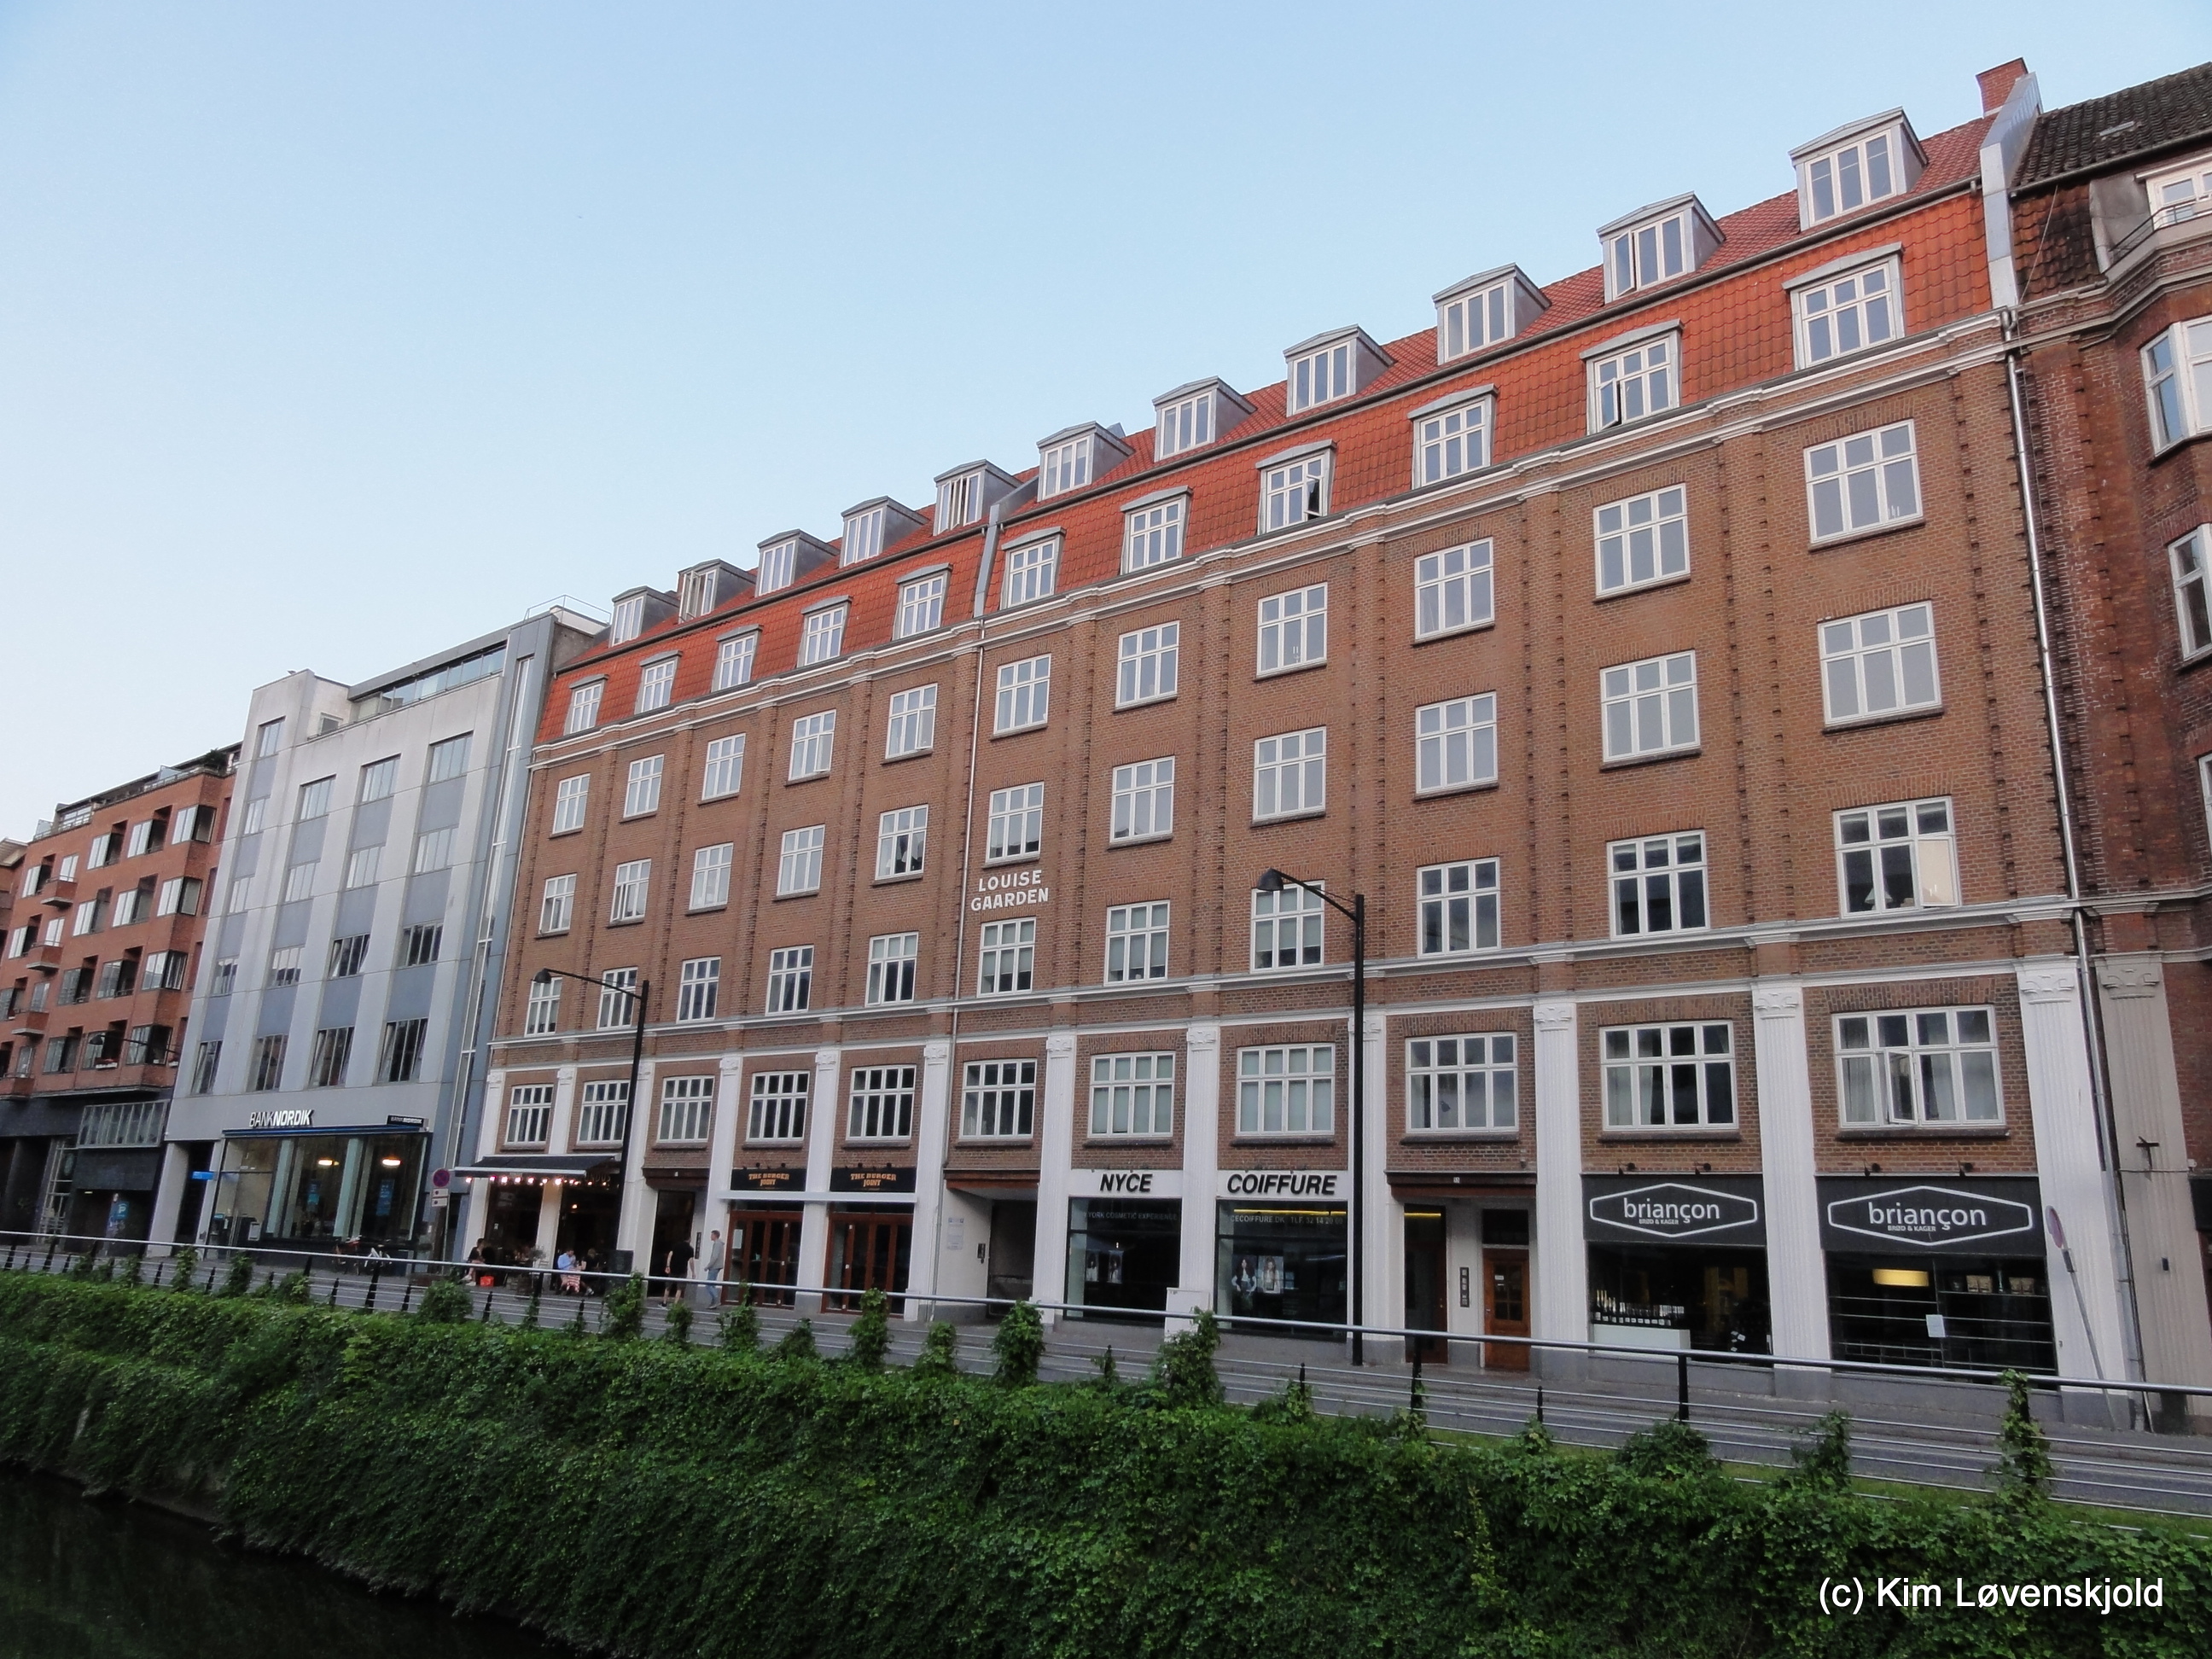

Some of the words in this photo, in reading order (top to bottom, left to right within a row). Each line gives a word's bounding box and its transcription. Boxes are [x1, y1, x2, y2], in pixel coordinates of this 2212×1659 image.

[978, 870, 1042, 892] LOUISE
[970, 888, 1049, 911] GAARDEN
[249, 1109, 313, 1127] BANKNORDIK
[866, 1173, 897, 1181] BURGER
[1099, 1173, 1153, 1193] NYCE
[1227, 1173, 1337, 1195] COIFFURE
[1138, 1212, 1178, 1220] EXPERIENCE
[1623, 1197, 1720, 1224] briançon
[1867, 1202, 1987, 1231] briançon
